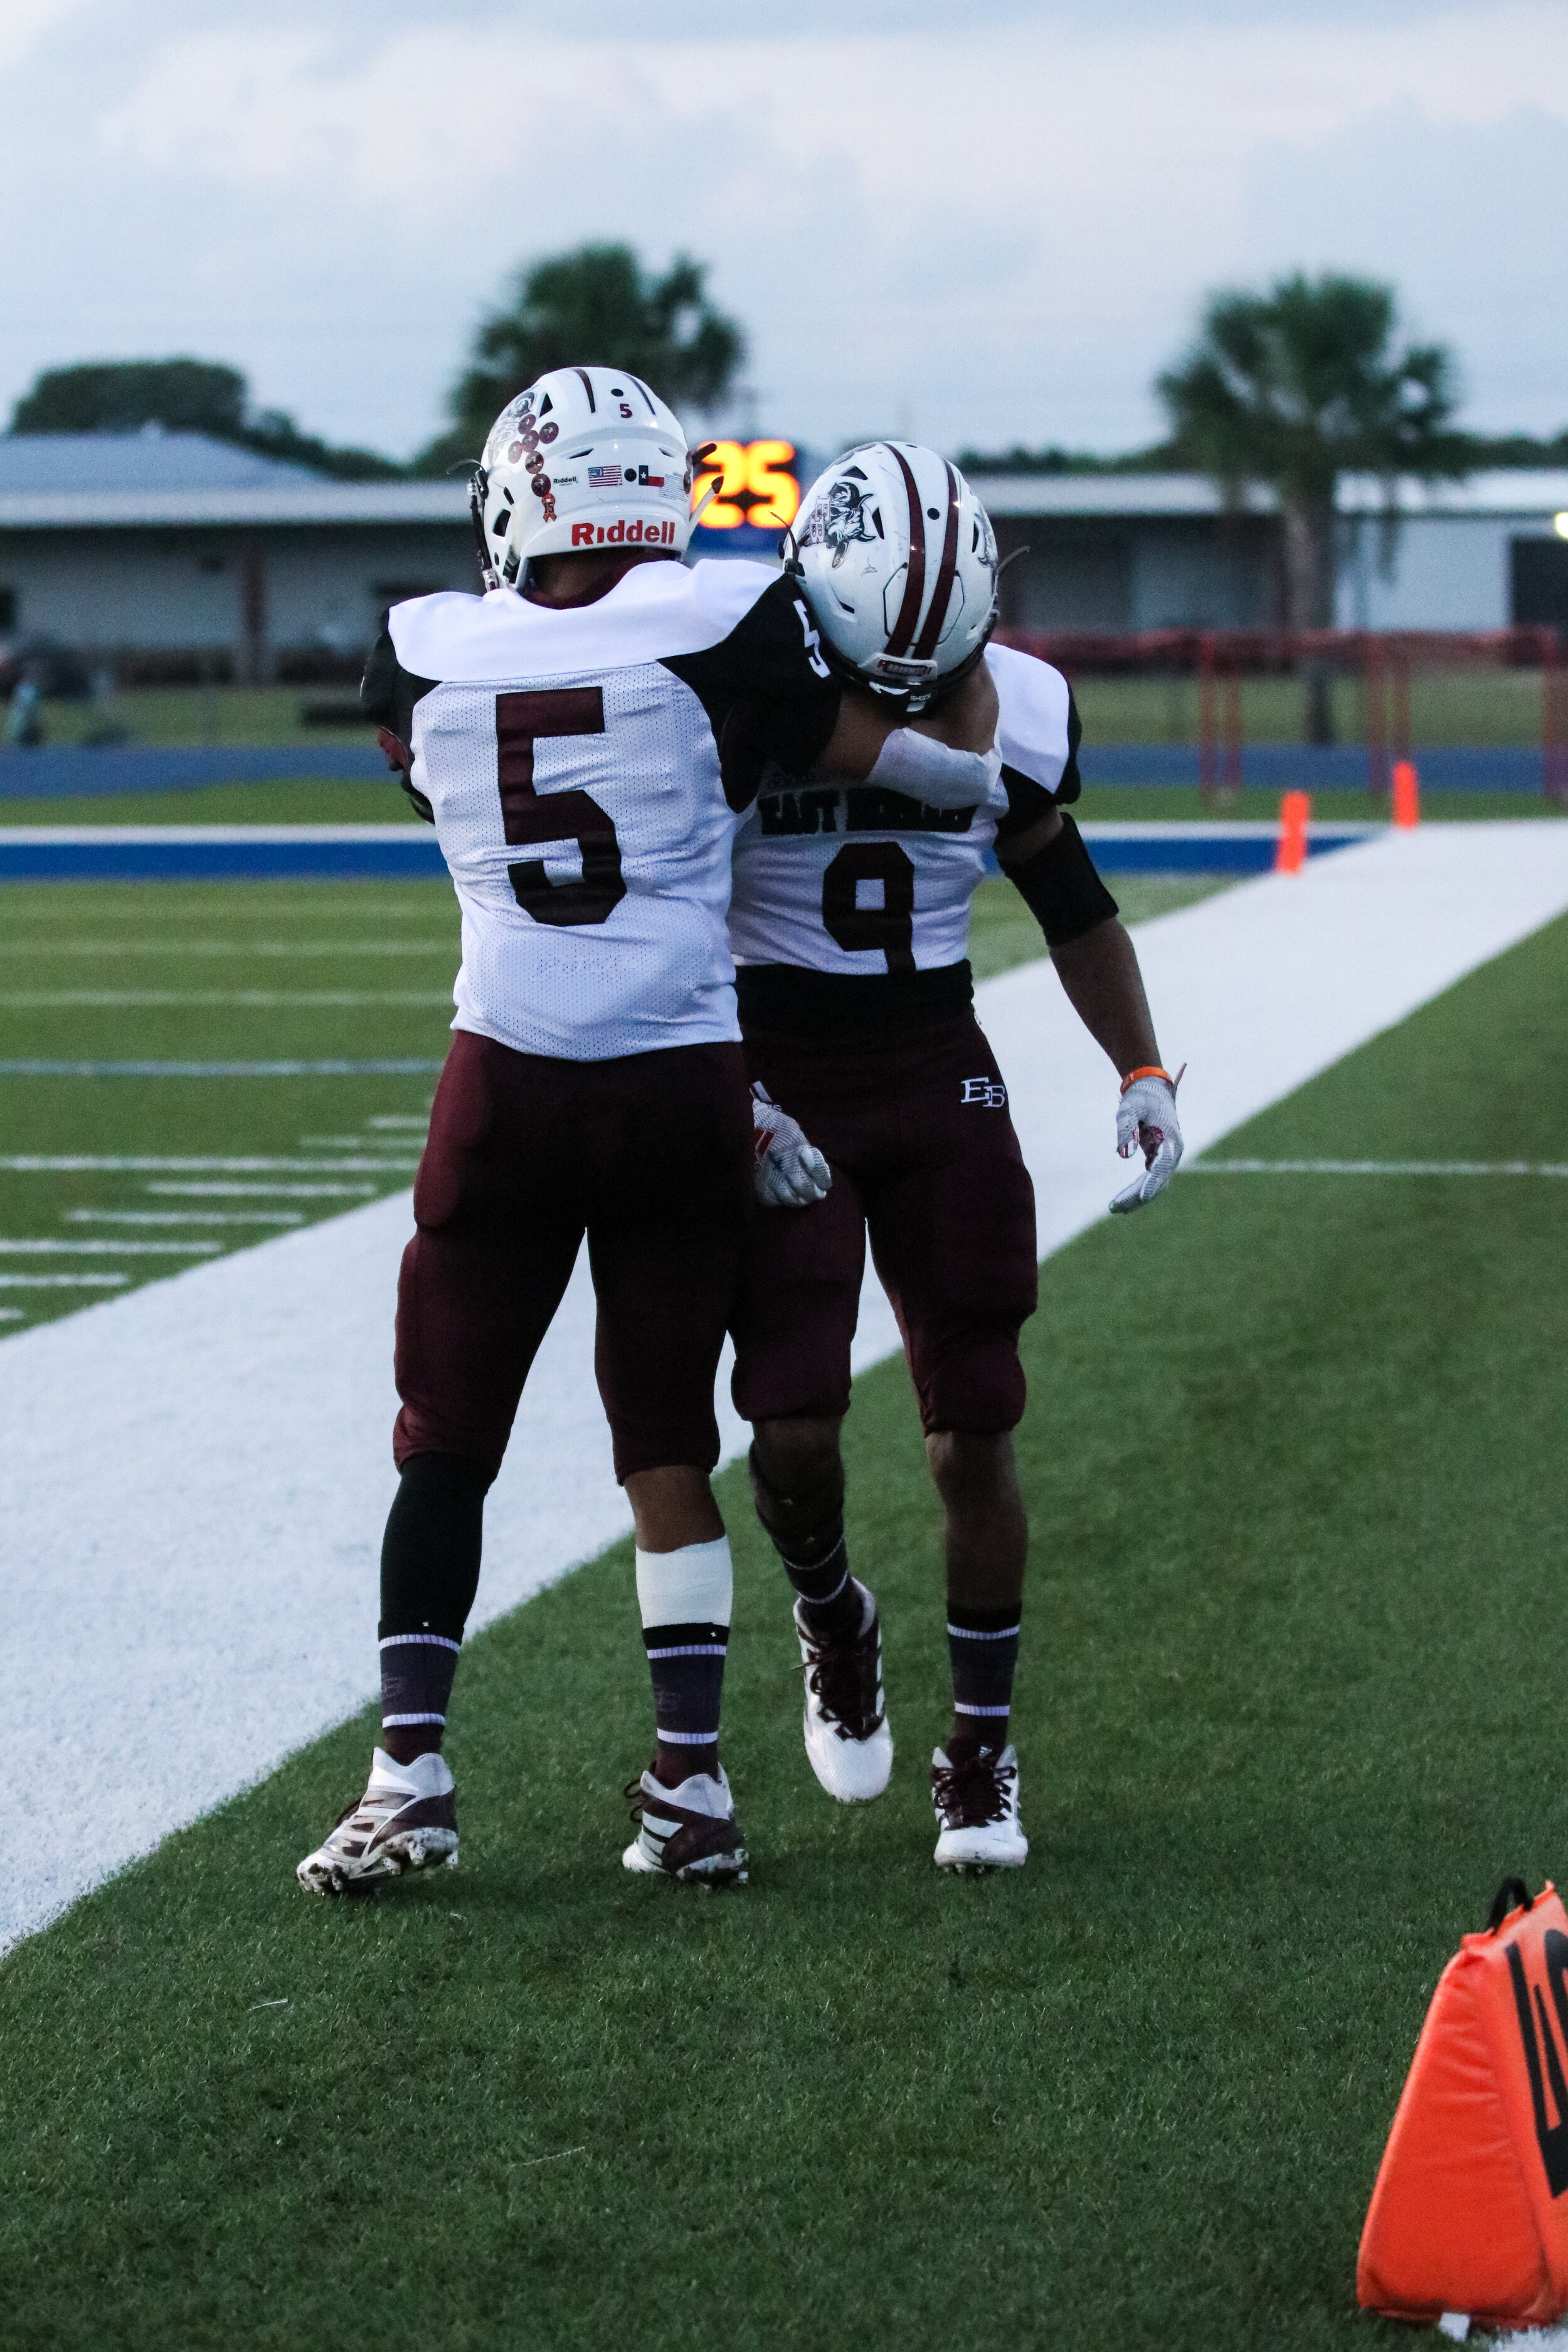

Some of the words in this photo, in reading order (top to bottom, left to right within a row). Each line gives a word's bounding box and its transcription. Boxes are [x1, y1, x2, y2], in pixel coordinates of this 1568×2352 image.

[619, 403, 633, 418] 5
[553, 476, 576, 484] Riddell
[692, 439, 800, 529] 25
[571, 519, 675, 546] Riddell
[496, 686, 627, 927] 5
[822, 841, 916, 975] 9
[960, 1076, 1005, 1108] EB
